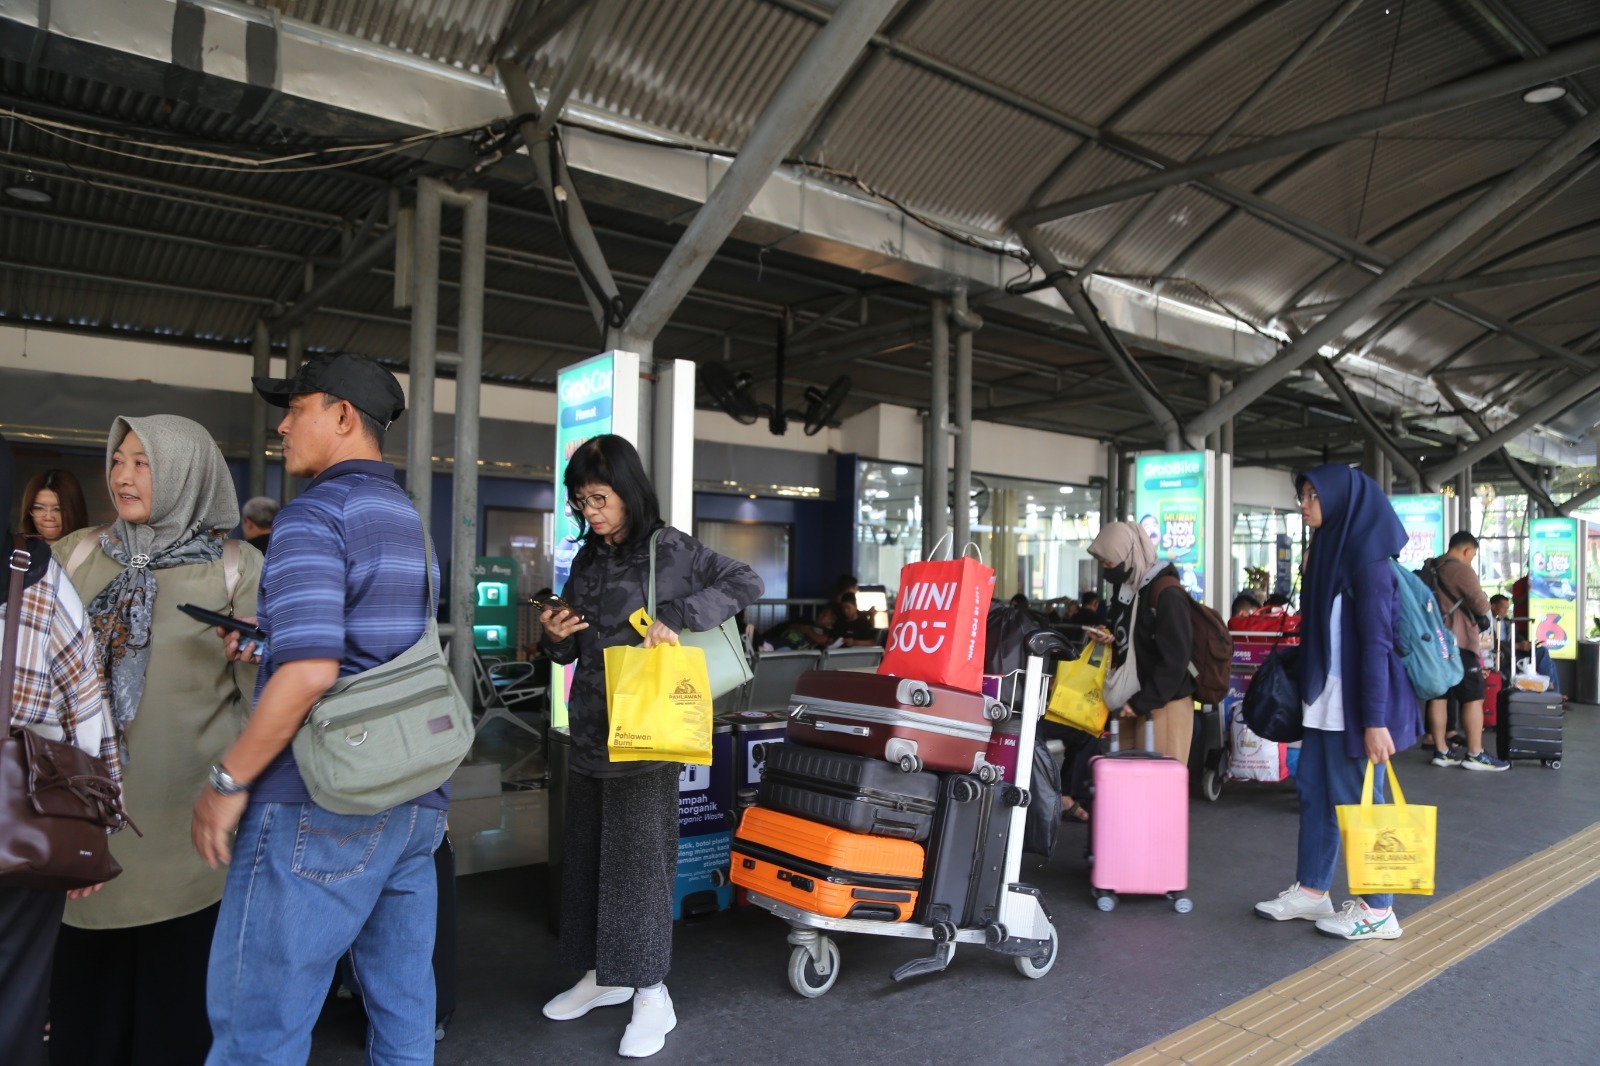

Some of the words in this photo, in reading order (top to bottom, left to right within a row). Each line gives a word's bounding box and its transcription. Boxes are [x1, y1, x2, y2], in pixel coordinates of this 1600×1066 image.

[560, 369, 613, 403] GrabCar
[1143, 460, 1200, 476] GrabBike
[1166, 521, 1194, 534] NON
[1162, 534, 1196, 548] STOP
[900, 582, 958, 612] MINI
[1536, 613, 1568, 650] 6
[615, 732, 652, 740] Pahlawan
[679, 794, 708, 806] ampah
[679, 802, 718, 815] norganik
[678, 815, 702, 825] organic
[704, 812, 724, 821] Waste
[678, 841, 695, 849] astik,
[1364, 853, 1416, 862] PAHLAWAN
